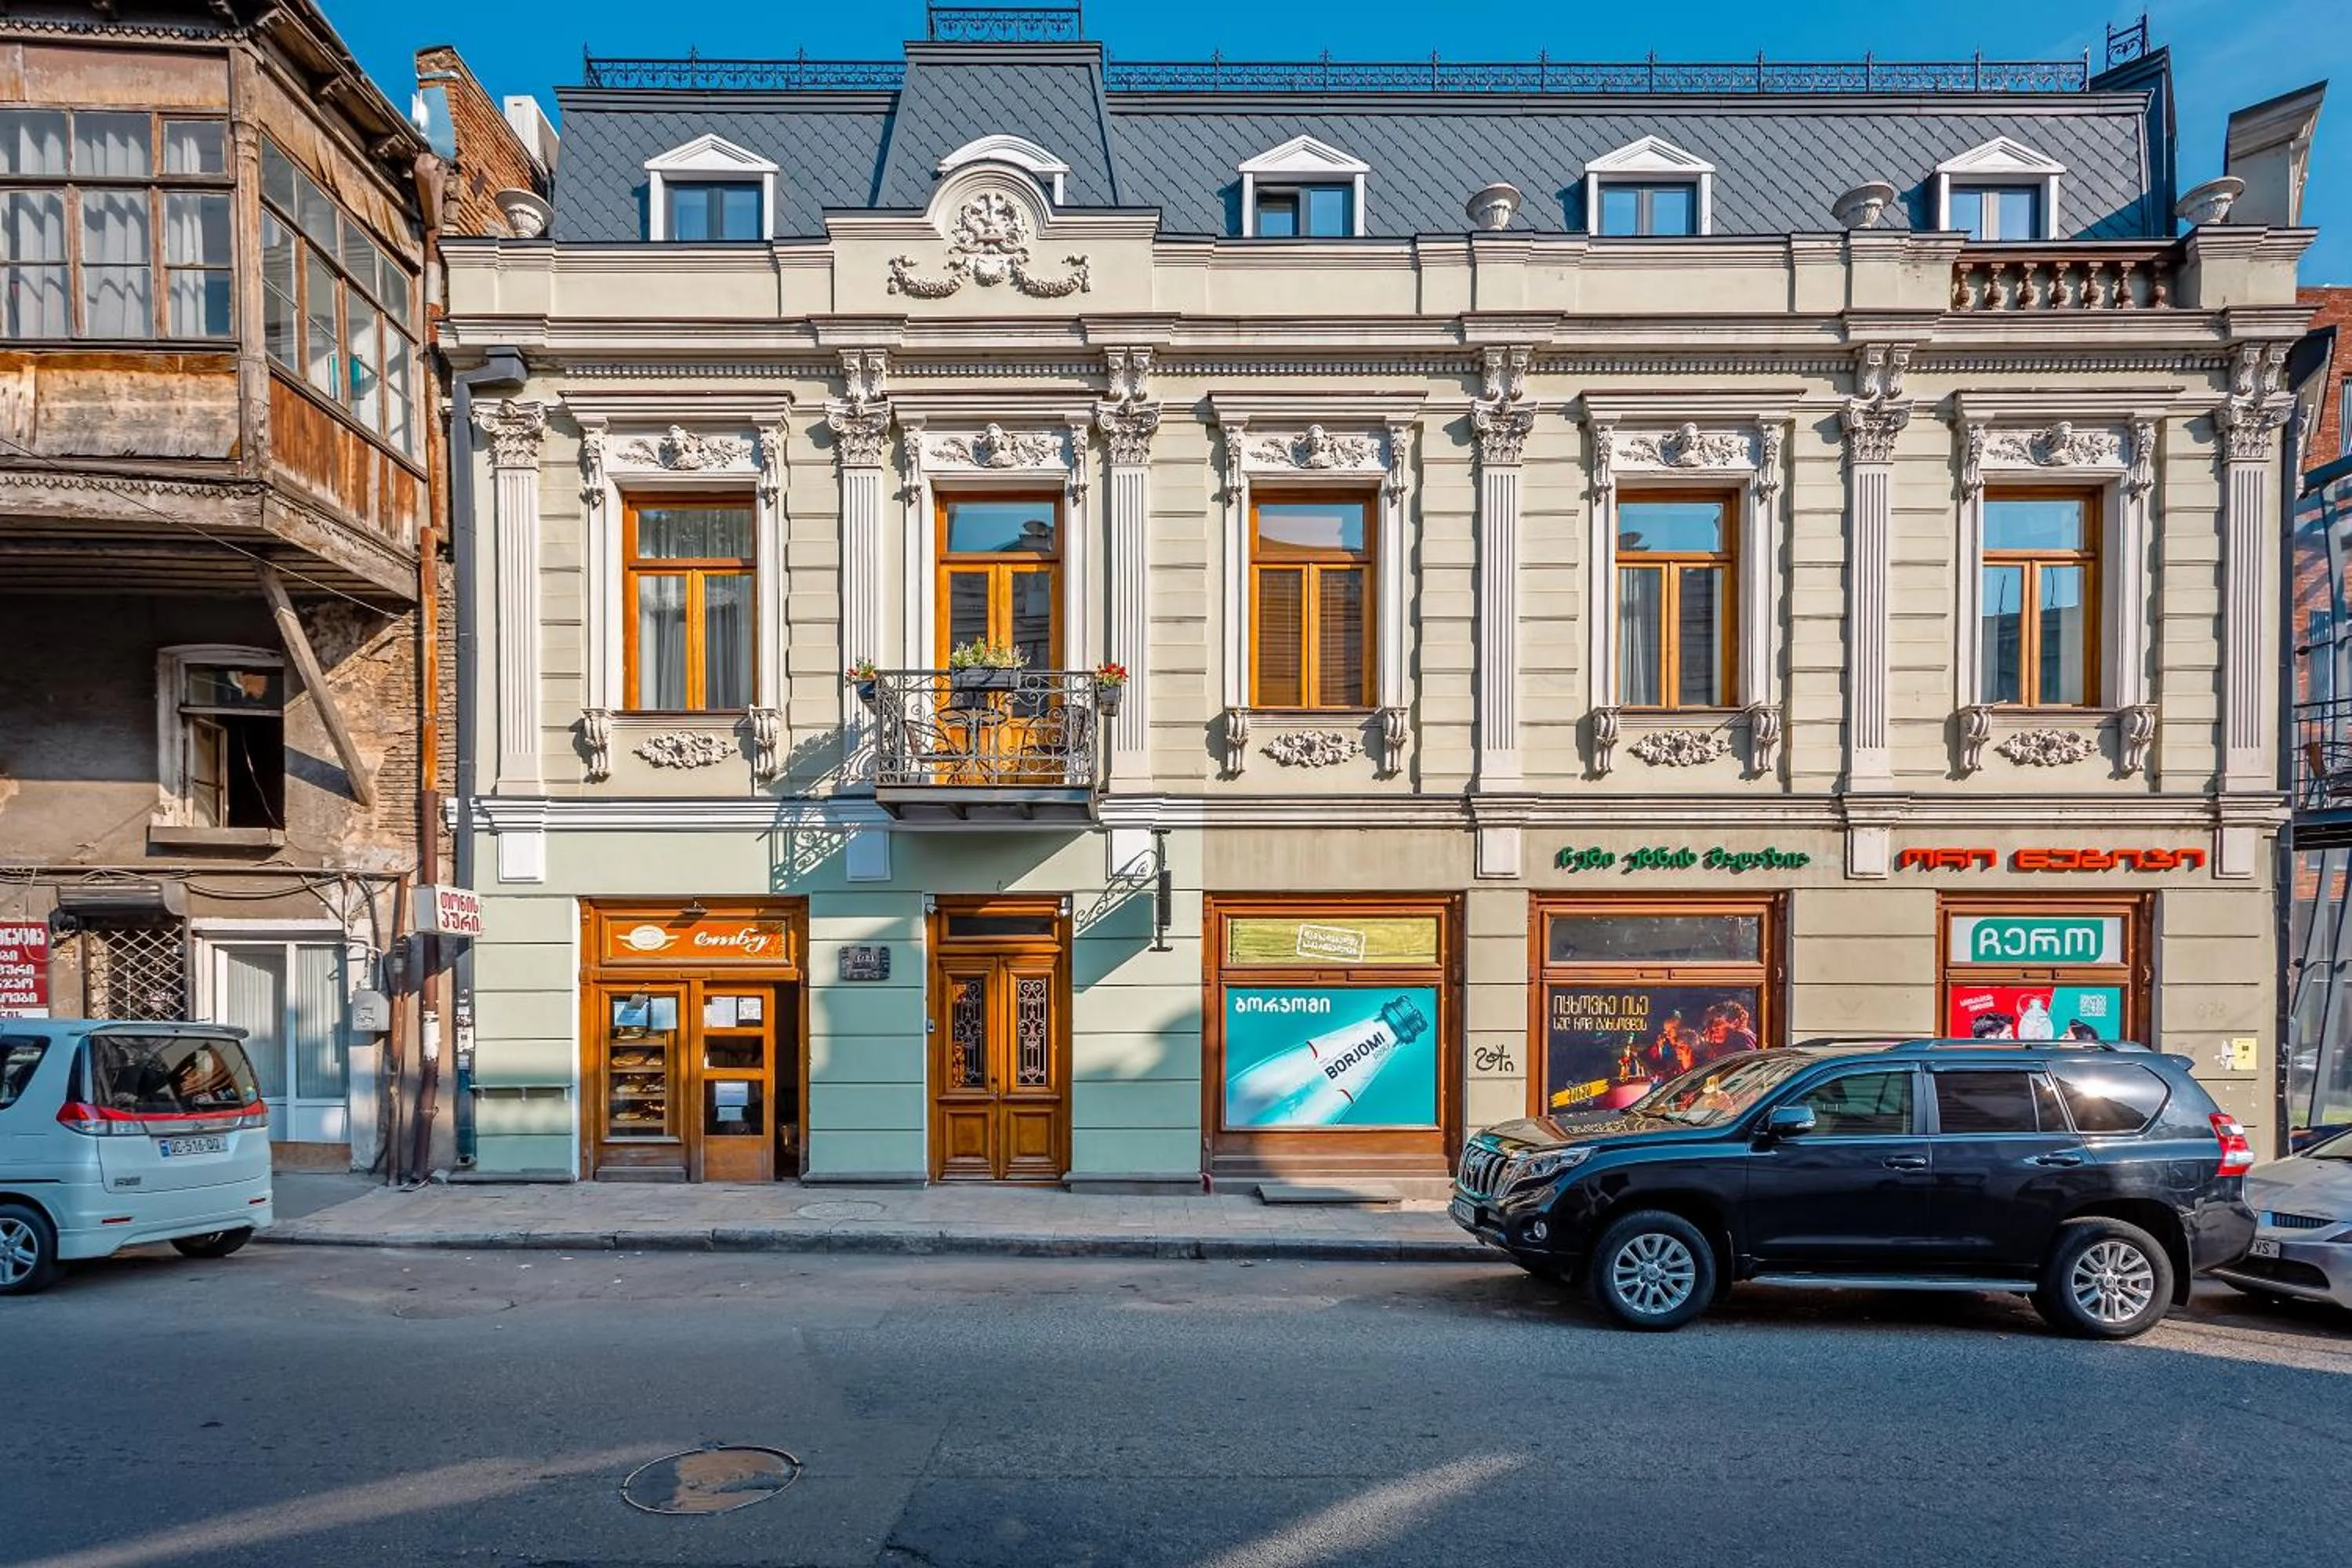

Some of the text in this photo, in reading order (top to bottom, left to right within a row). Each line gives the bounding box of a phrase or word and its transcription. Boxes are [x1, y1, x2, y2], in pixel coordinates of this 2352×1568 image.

[1560, 847, 1808, 870] ჩემი უბნის მაღაზია
[1900, 848, 1998, 869] ორი
[440, 891, 479, 914] თონის
[441, 910, 480, 932] პური
[1979, 927, 2096, 956] ჩერო
[1235, 996, 1330, 1013] ბორჯომი
[1621, 995, 1649, 1015] ისე
[1324, 1031, 1386, 1080] BORJOMI
